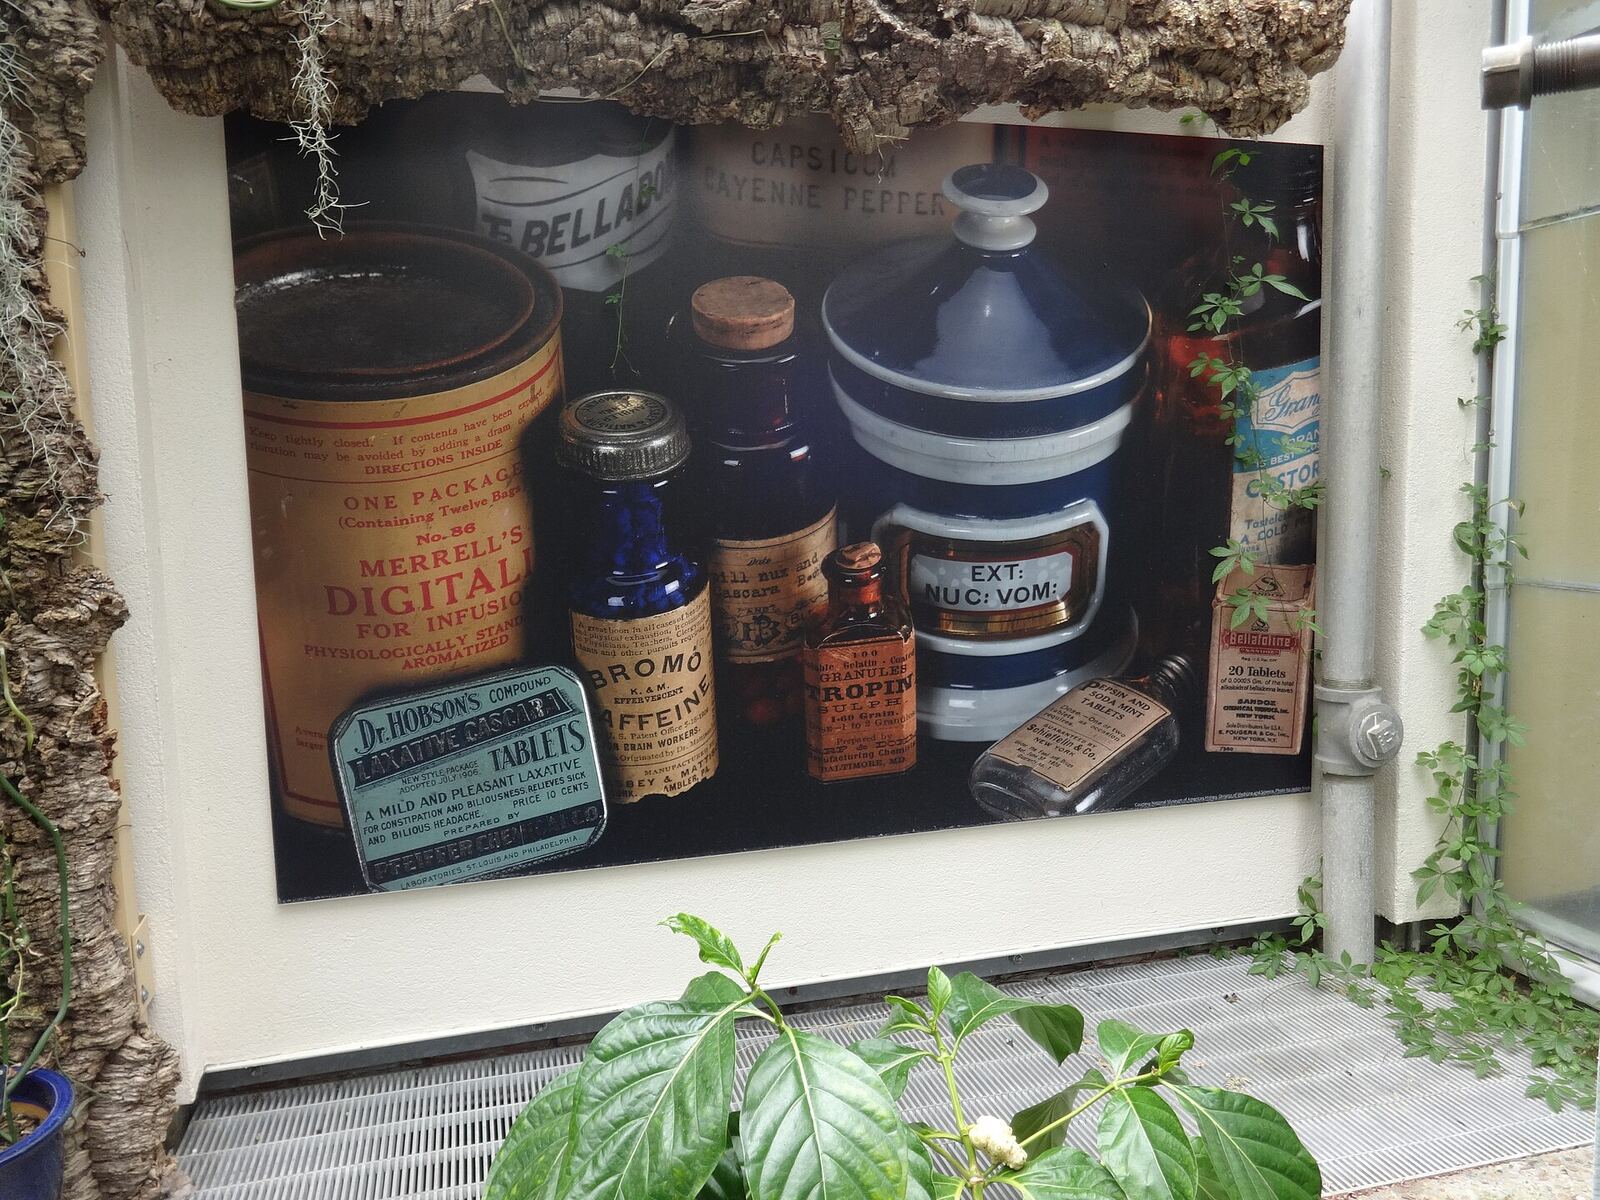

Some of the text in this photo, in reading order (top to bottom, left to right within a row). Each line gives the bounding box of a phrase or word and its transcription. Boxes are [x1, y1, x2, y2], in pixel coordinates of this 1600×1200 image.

[844, 186, 945, 216] PEPPER
[285, 435, 323, 448] tightly
[333, 438, 374, 448] closed.
[393, 435, 404, 445] If
[411, 427, 458, 443] contents
[463, 418, 487, 432] have
[492, 408, 512, 422] been
[304, 451, 329, 461] may
[336, 452, 350, 462] be
[357, 449, 403, 462] avoided
[412, 446, 426, 458] by
[433, 436, 469, 454] adding
[487, 424, 512, 438] dram
[365, 439, 503, 475] DIRECTIONS INSIDE
[1245, 460, 1320, 498] CSTOR
[338, 510, 435, 530] (Containing
[438, 498, 488, 518] Twelve
[343, 495, 398, 511] ONE
[416, 533, 448, 546] No.
[1257, 523, 1288, 541] COLD
[359, 525, 524, 578] MERRELL'S
[796, 552, 818, 573] and
[971, 563, 1024, 582] EXT:
[924, 581, 1058, 606] NUC: VOM:
[356, 623, 411, 639] FOR
[643, 623, 655, 632] all
[655, 619, 676, 630] cases
[304, 634, 467, 661] PHYSIOLOGICALLY
[402, 634, 509, 671] AROMATIZED
[621, 649, 644, 657] other
[647, 641, 679, 655] pursuits
[588, 650, 702, 691] BROMO
[819, 664, 907, 683] GRANULES
[843, 660, 877, 669] Gelatin
[1228, 665, 1286, 678] 20 Tablets
[386, 693, 483, 740] HOBSON'S
[489, 676, 552, 704] COMPOUND
[614, 686, 684, 705] EFFERVESCENT
[1079, 681, 1151, 711] PEPSIN AND
[1089, 690, 1145, 719] SODA MINT
[1080, 697, 1126, 721] TABLETS
[488, 720, 585, 772] TABLETS
[623, 742, 653, 752] BRAIN
[657, 726, 701, 748] WORKERS.
[630, 731, 658, 740] Patent
[836, 732, 893, 746] Prepared by
[1033, 737, 1077, 757] NEW YORK
[356, 727, 460, 780] LAXATIVE
[1073, 743, 1084, 752] &
[1082, 747, 1097, 761] Co.
[399, 774, 457, 795] ADOPTED JULY
[401, 760, 480, 785] NEW STYLE PACKAGE
[364, 758, 582, 822] A MILD AND PLEASANT LAXATIVE
[512, 781, 590, 809] PRICE 10 CENTS
[363, 824, 379, 836] FOR
[381, 808, 443, 831] CONSTIPATION
[446, 803, 464, 814] AND
[528, 776, 565, 793] RELIEVES
[567, 771, 587, 783] SICK
[368, 834, 386, 846] AND
[391, 823, 431, 840] BILIOUS
[443, 811, 521, 838] PREPARED BY
[503, 851, 519, 861] AND
[522, 835, 578, 855] PHILADELPHIA
